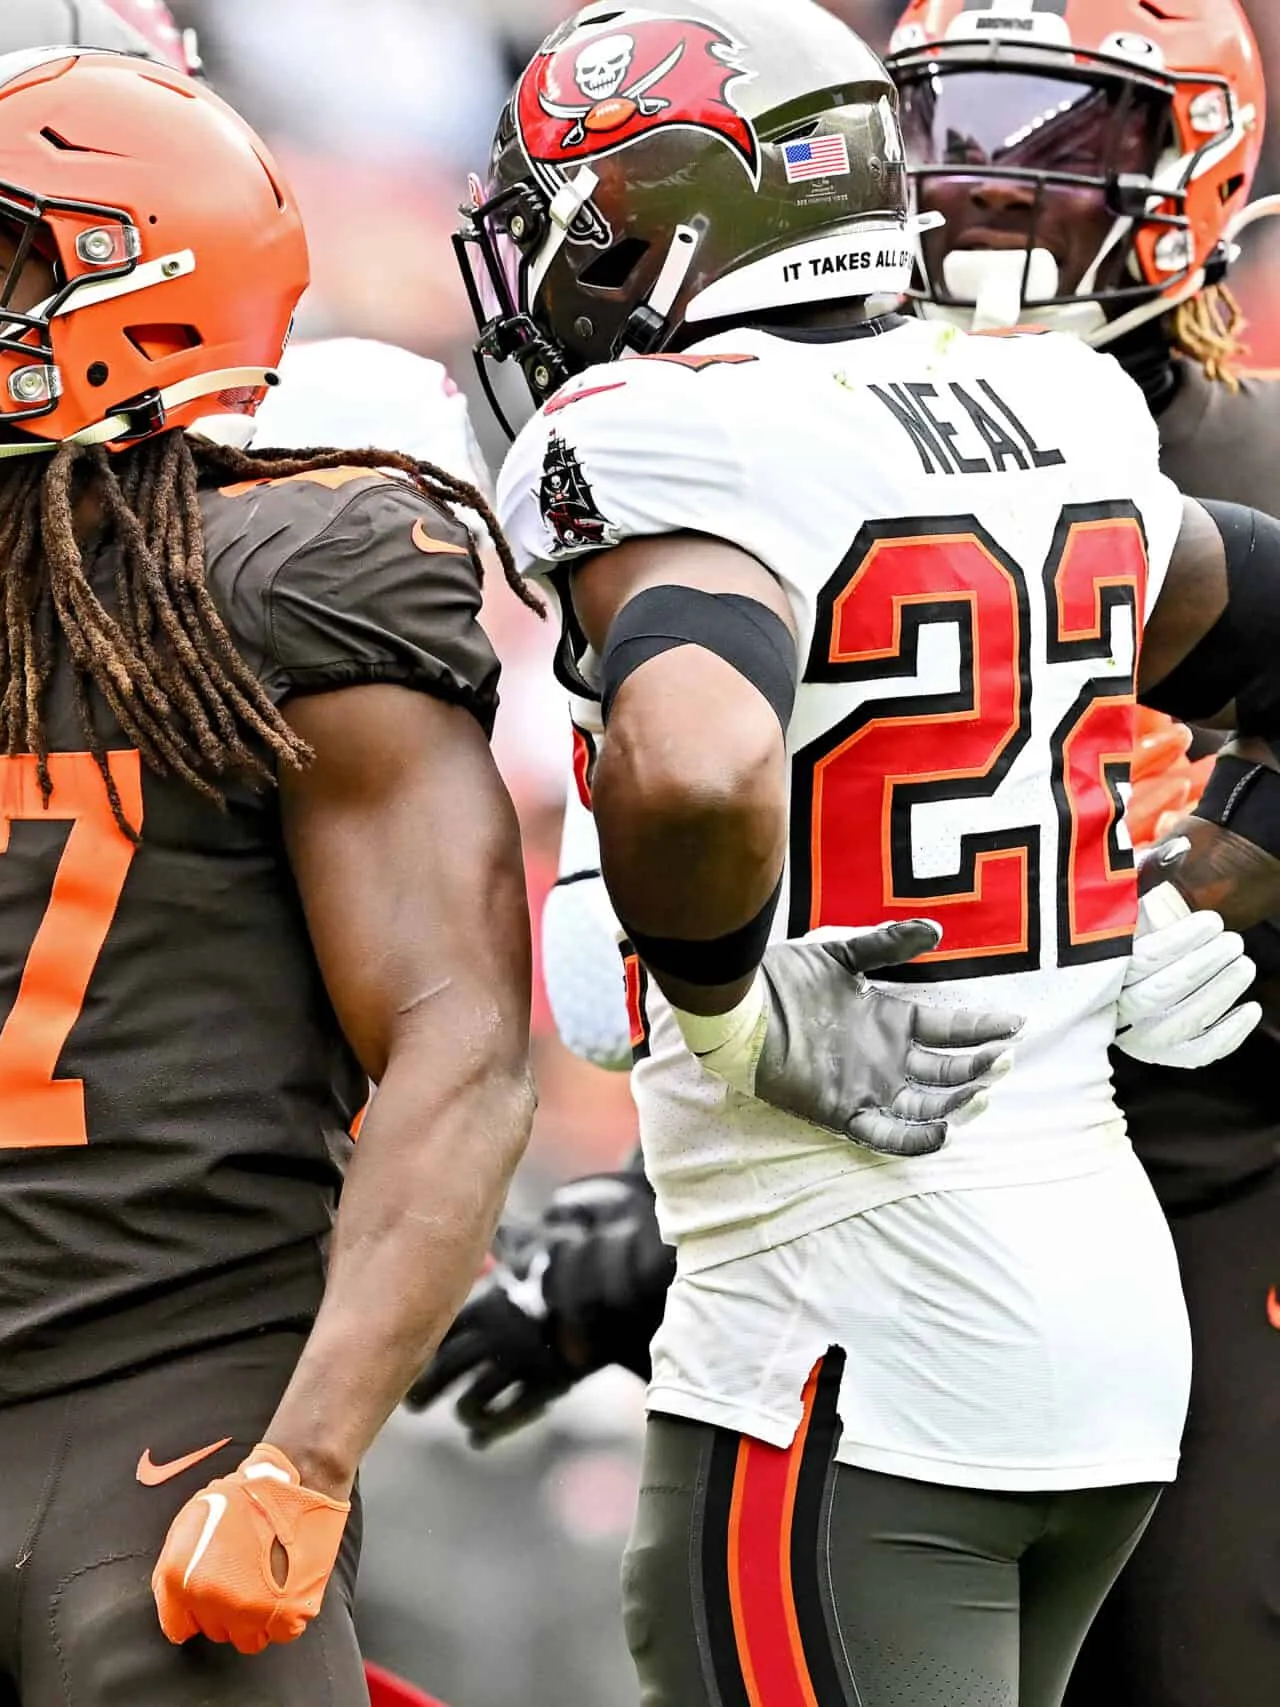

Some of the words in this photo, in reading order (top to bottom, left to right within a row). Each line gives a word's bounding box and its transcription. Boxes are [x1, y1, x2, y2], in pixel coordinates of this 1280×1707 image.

[783, 262, 802, 282] IT
[808, 252, 871, 276] TAKES
[875, 249, 897, 267] ALL
[867, 378, 1066, 475] NEAL
[787, 498, 1149, 984] 22
